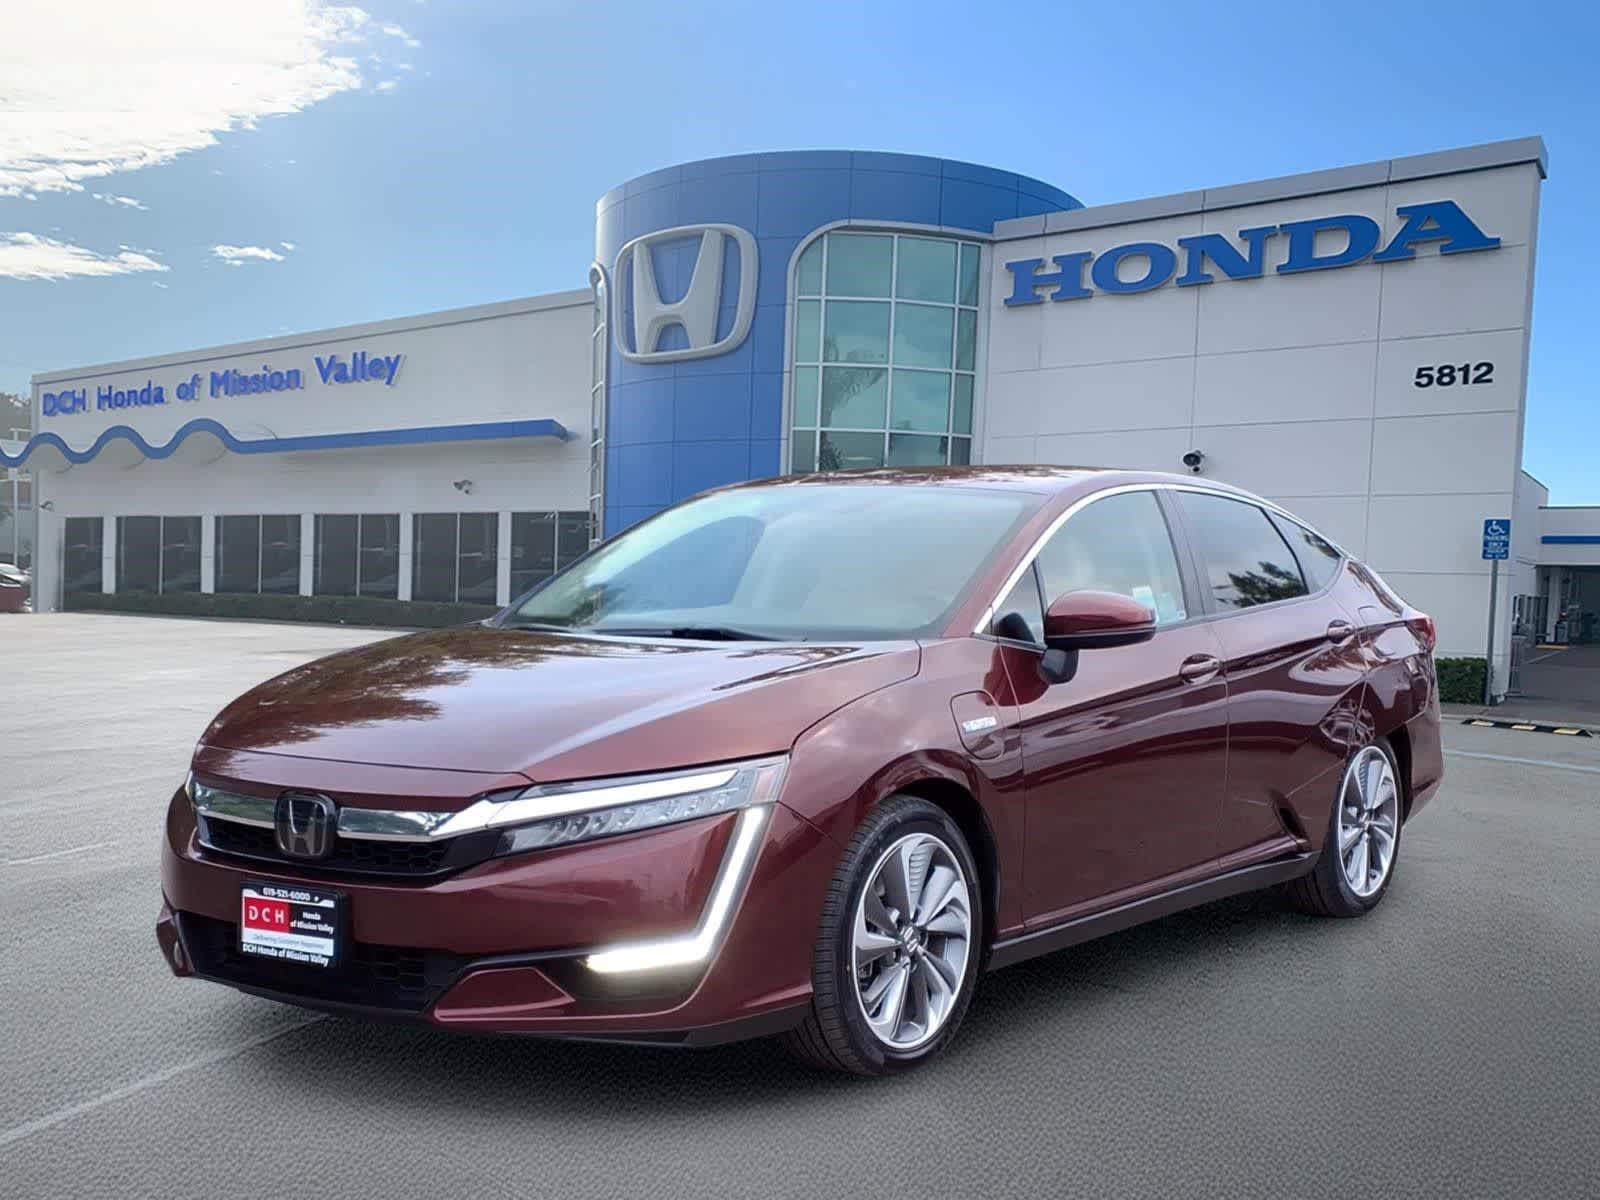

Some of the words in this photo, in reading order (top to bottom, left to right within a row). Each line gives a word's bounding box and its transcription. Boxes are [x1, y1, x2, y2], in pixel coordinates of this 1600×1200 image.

[1003, 199, 1502, 308] HONDA
[42, 389, 87, 416] DCH
[97, 380, 164, 410] Honda
[176, 374, 201, 400] of
[210, 366, 304, 398] Mission
[314, 352, 405, 386] Valley
[1413, 362, 1494, 389] 5812
[249, 906, 284, 923] DCH
[302, 911, 321, 920] Honda
[318, 922, 334, 935] Valley
[242, 943, 257, 953] DCH
[257, 945, 278, 957] Honda
[278, 948, 286, 958] of
[286, 951, 309, 962] Mission
[310, 954, 329, 967] Valley
